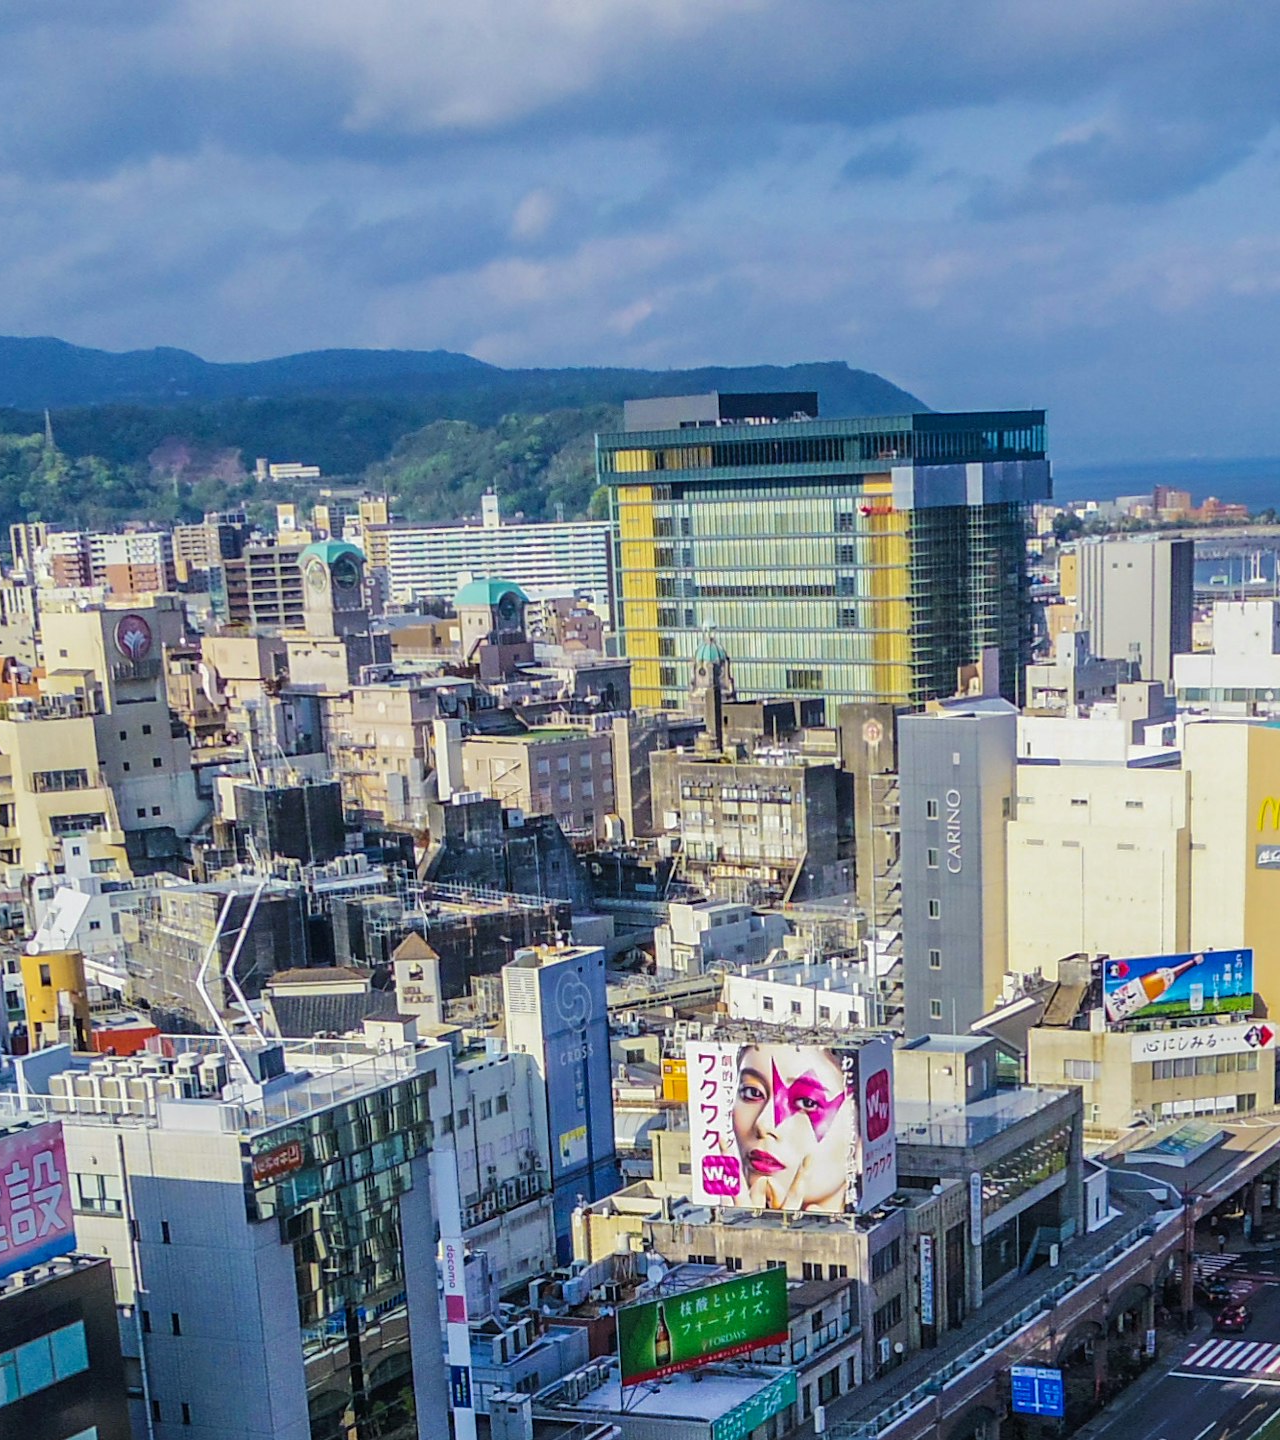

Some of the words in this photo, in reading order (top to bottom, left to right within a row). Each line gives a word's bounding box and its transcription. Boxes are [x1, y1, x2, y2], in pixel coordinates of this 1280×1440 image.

[946, 789, 962, 874] CARINO
[560, 1044, 594, 1067] CROSS
[698, 1053, 721, 1150] ワクワク
[446, 1244, 456, 1289] docomo
[680, 1281, 770, 1318] 核酸といえば、
[681, 1301, 770, 1336] フォーデイズ。
[708, 1329, 747, 1349] FORDAYS
